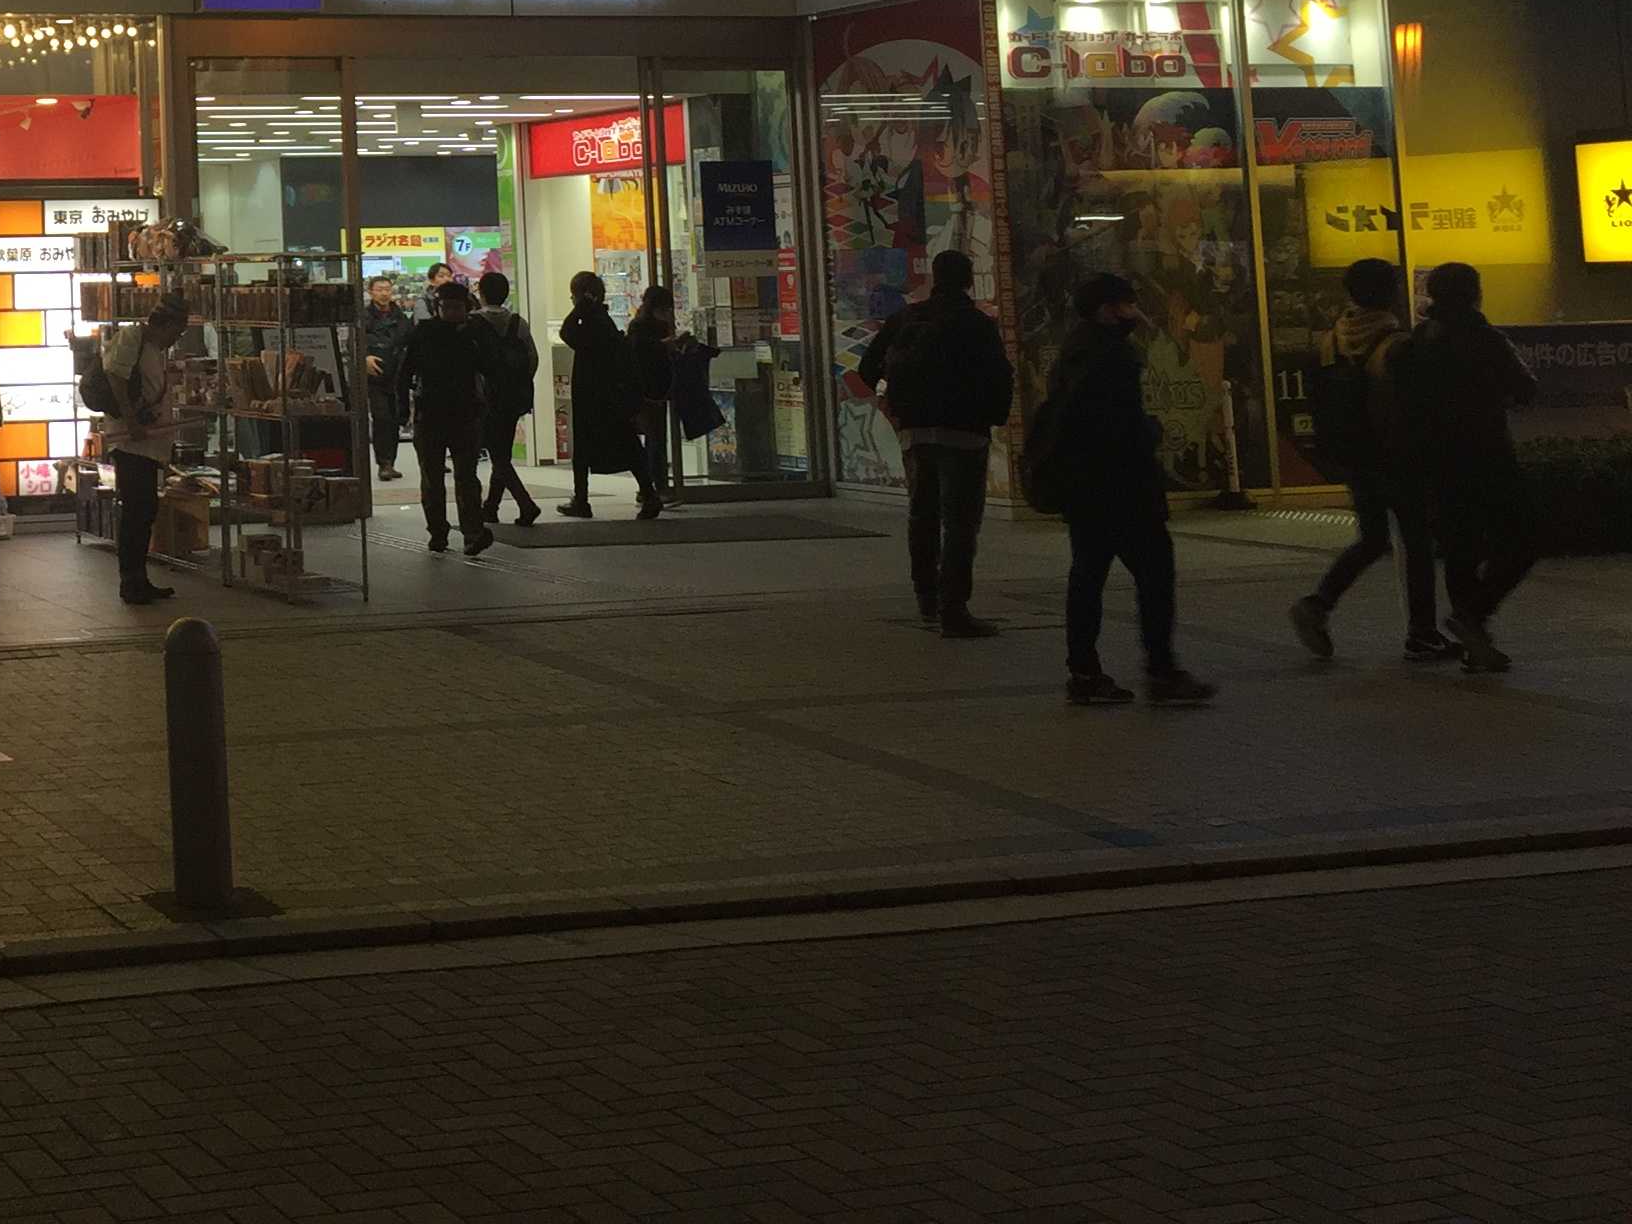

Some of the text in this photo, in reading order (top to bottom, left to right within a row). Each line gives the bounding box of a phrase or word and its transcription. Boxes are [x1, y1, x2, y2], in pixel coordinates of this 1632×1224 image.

[53, 209, 83, 225] 東京
[1611, 219, 1632, 228] LIO
[455, 239, 472, 253] 7F
[38, 247, 75, 262] おみや
